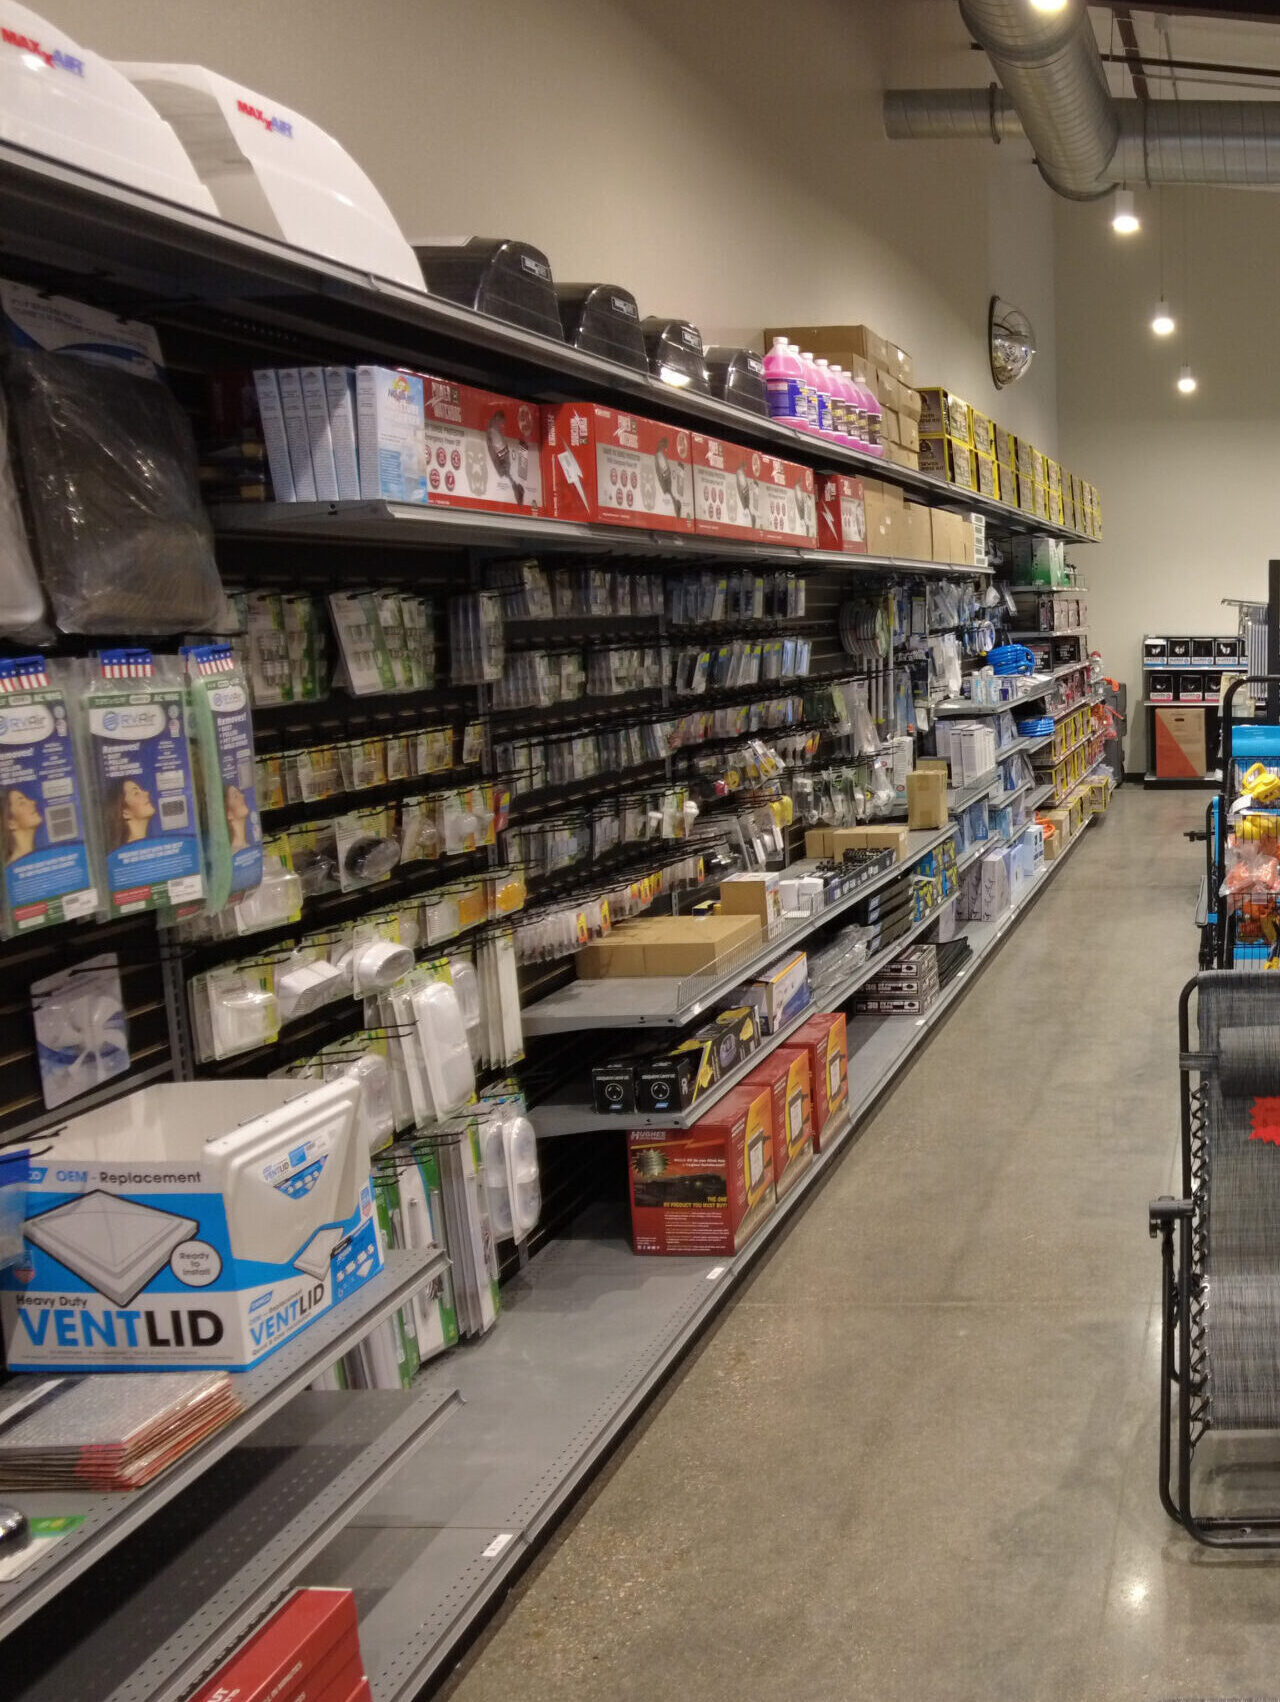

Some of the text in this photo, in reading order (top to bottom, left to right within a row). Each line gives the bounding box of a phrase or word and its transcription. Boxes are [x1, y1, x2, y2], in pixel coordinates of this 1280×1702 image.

[56, 1170, 88, 1183] OEM
[99, 1171, 202, 1185] Replacement
[180, 1252, 209, 1262] Ready
[16, 1295, 88, 1308] Heavy Duty
[250, 1283, 324, 1346] VENTLID
[18, 1308, 224, 1348] VENTLID
